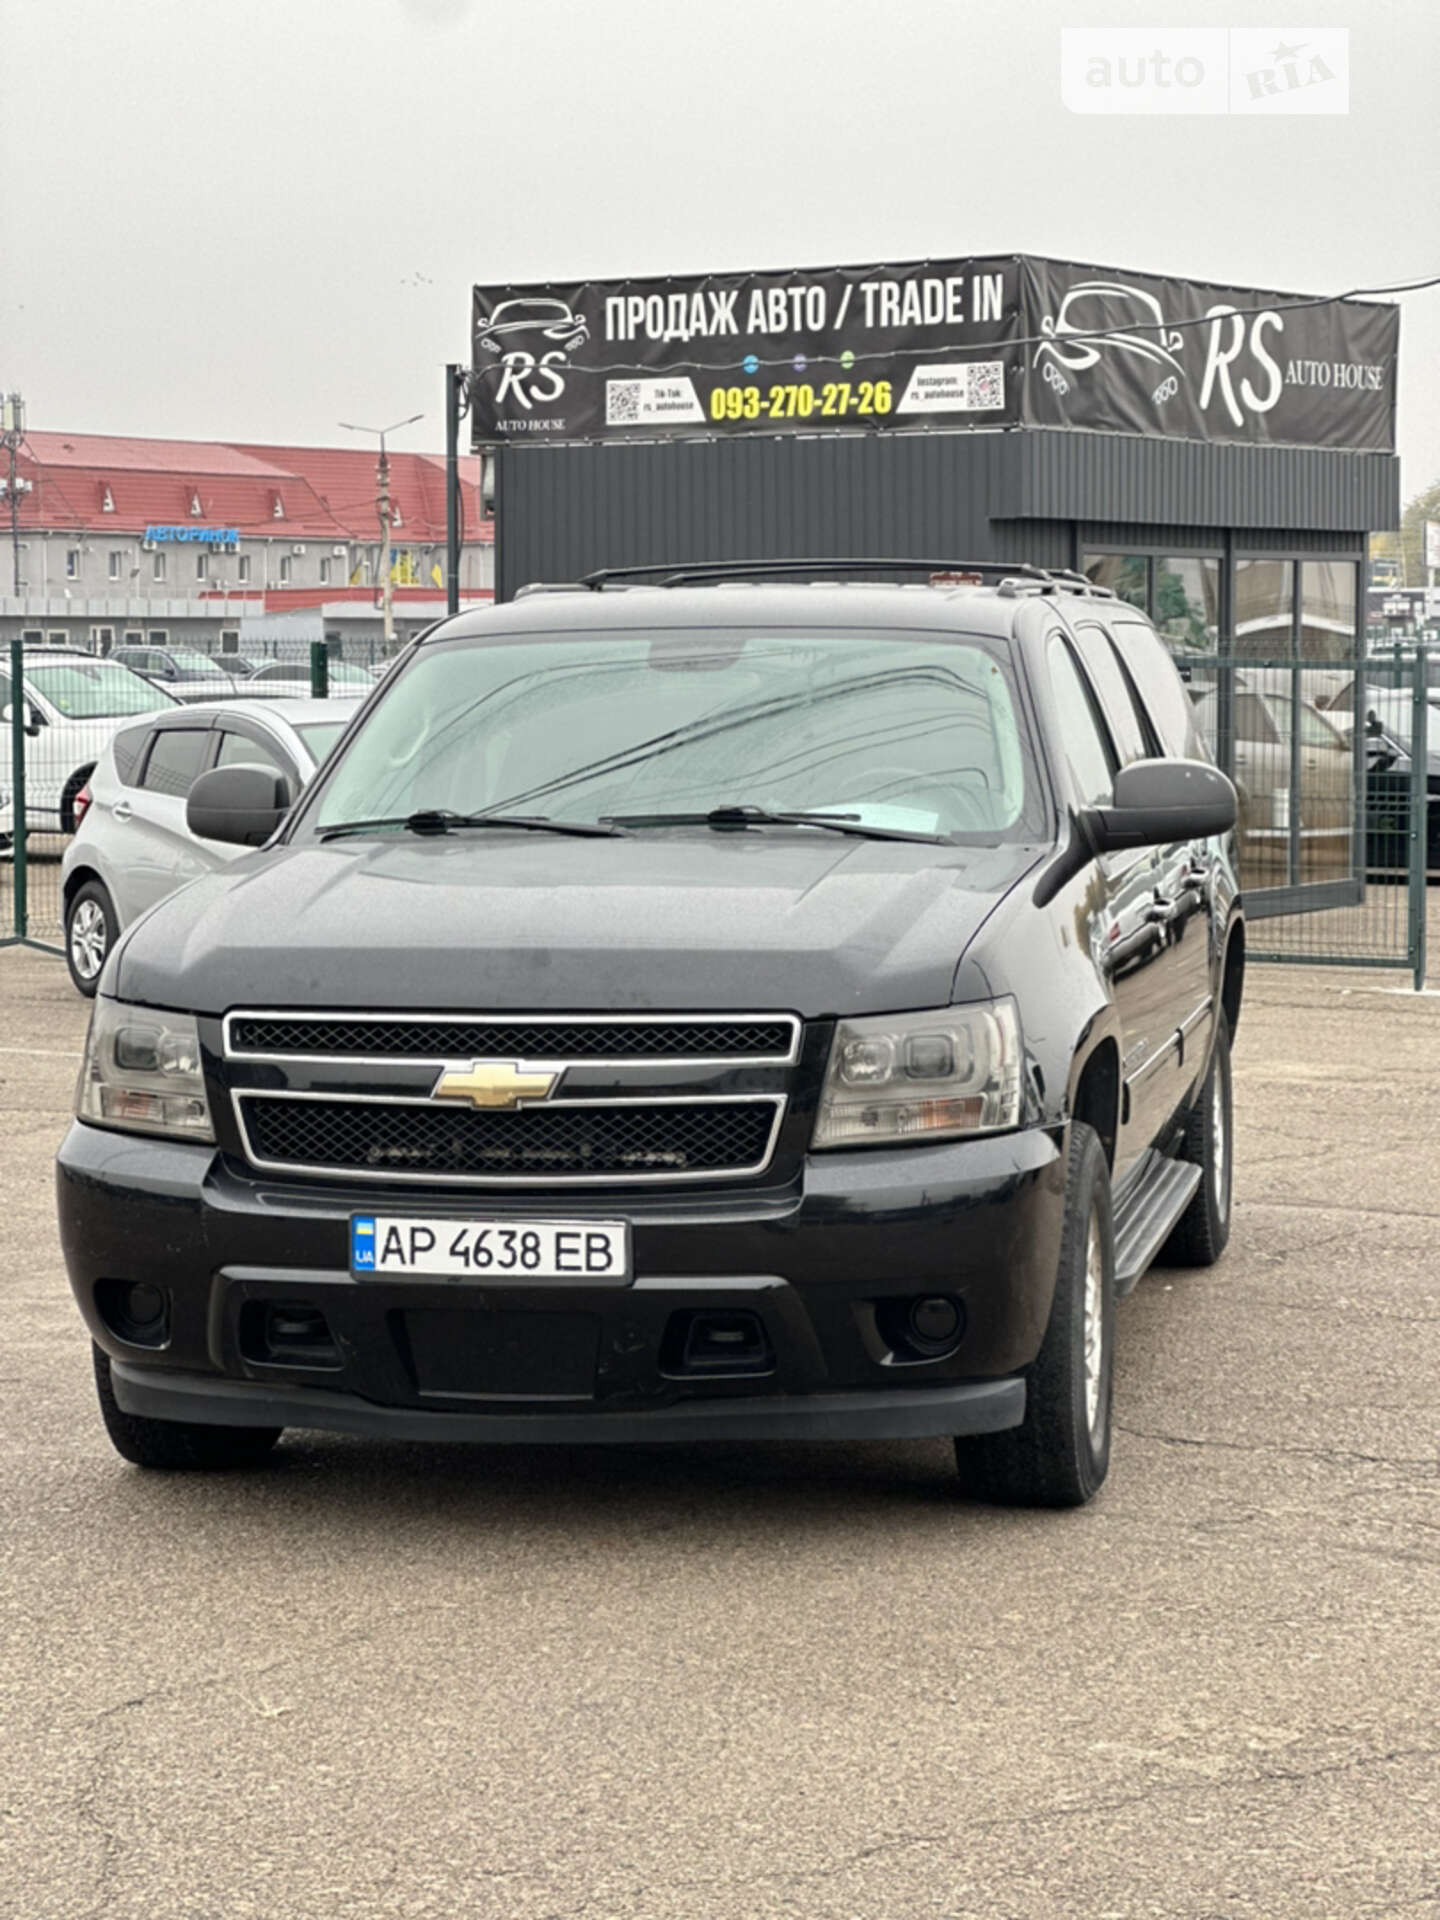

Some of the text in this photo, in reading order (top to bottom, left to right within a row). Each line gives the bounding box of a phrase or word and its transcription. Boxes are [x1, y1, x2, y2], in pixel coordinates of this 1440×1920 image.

[606, 274, 1004, 343] ПРОДАЖ АВТО / TRADE IN
[496, 351, 566, 409] RS
[1200, 305, 1283, 427] RS
[1285, 360, 1384, 390] AUTO HOUSE
[710, 380, 892, 420] 093-270-27-26
[495, 419, 566, 431] AUTO HOUSE
[356, 1250, 374, 1263] UA
[380, 1226, 613, 1272] AP 4638 EB
